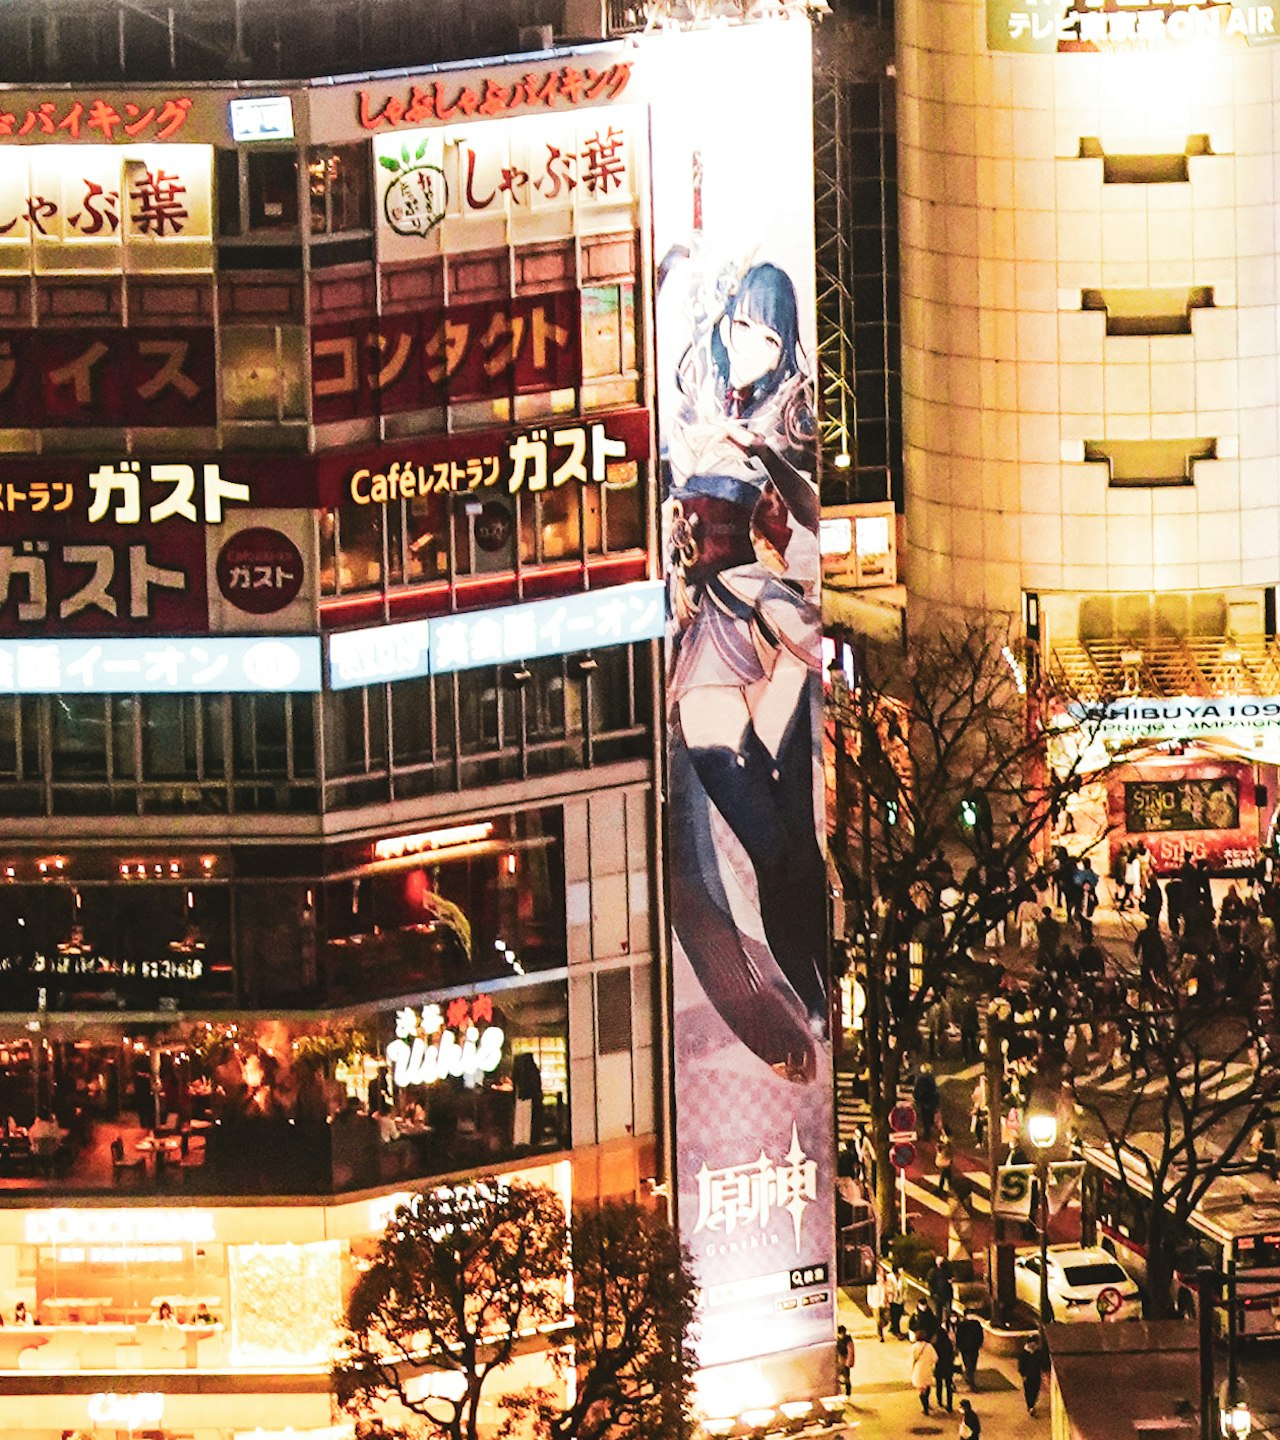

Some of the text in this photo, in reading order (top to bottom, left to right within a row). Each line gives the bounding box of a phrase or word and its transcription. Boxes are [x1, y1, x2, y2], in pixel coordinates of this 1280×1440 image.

[465, 126, 626, 211] しゃぶ葉
[312, 306, 572, 398] コンタクト
[87, 463, 250, 525] ガスト
[508, 423, 627, 494] ガスト
[229, 565, 294, 589] ガスト
[692, 1120, 818, 1254] 原神
